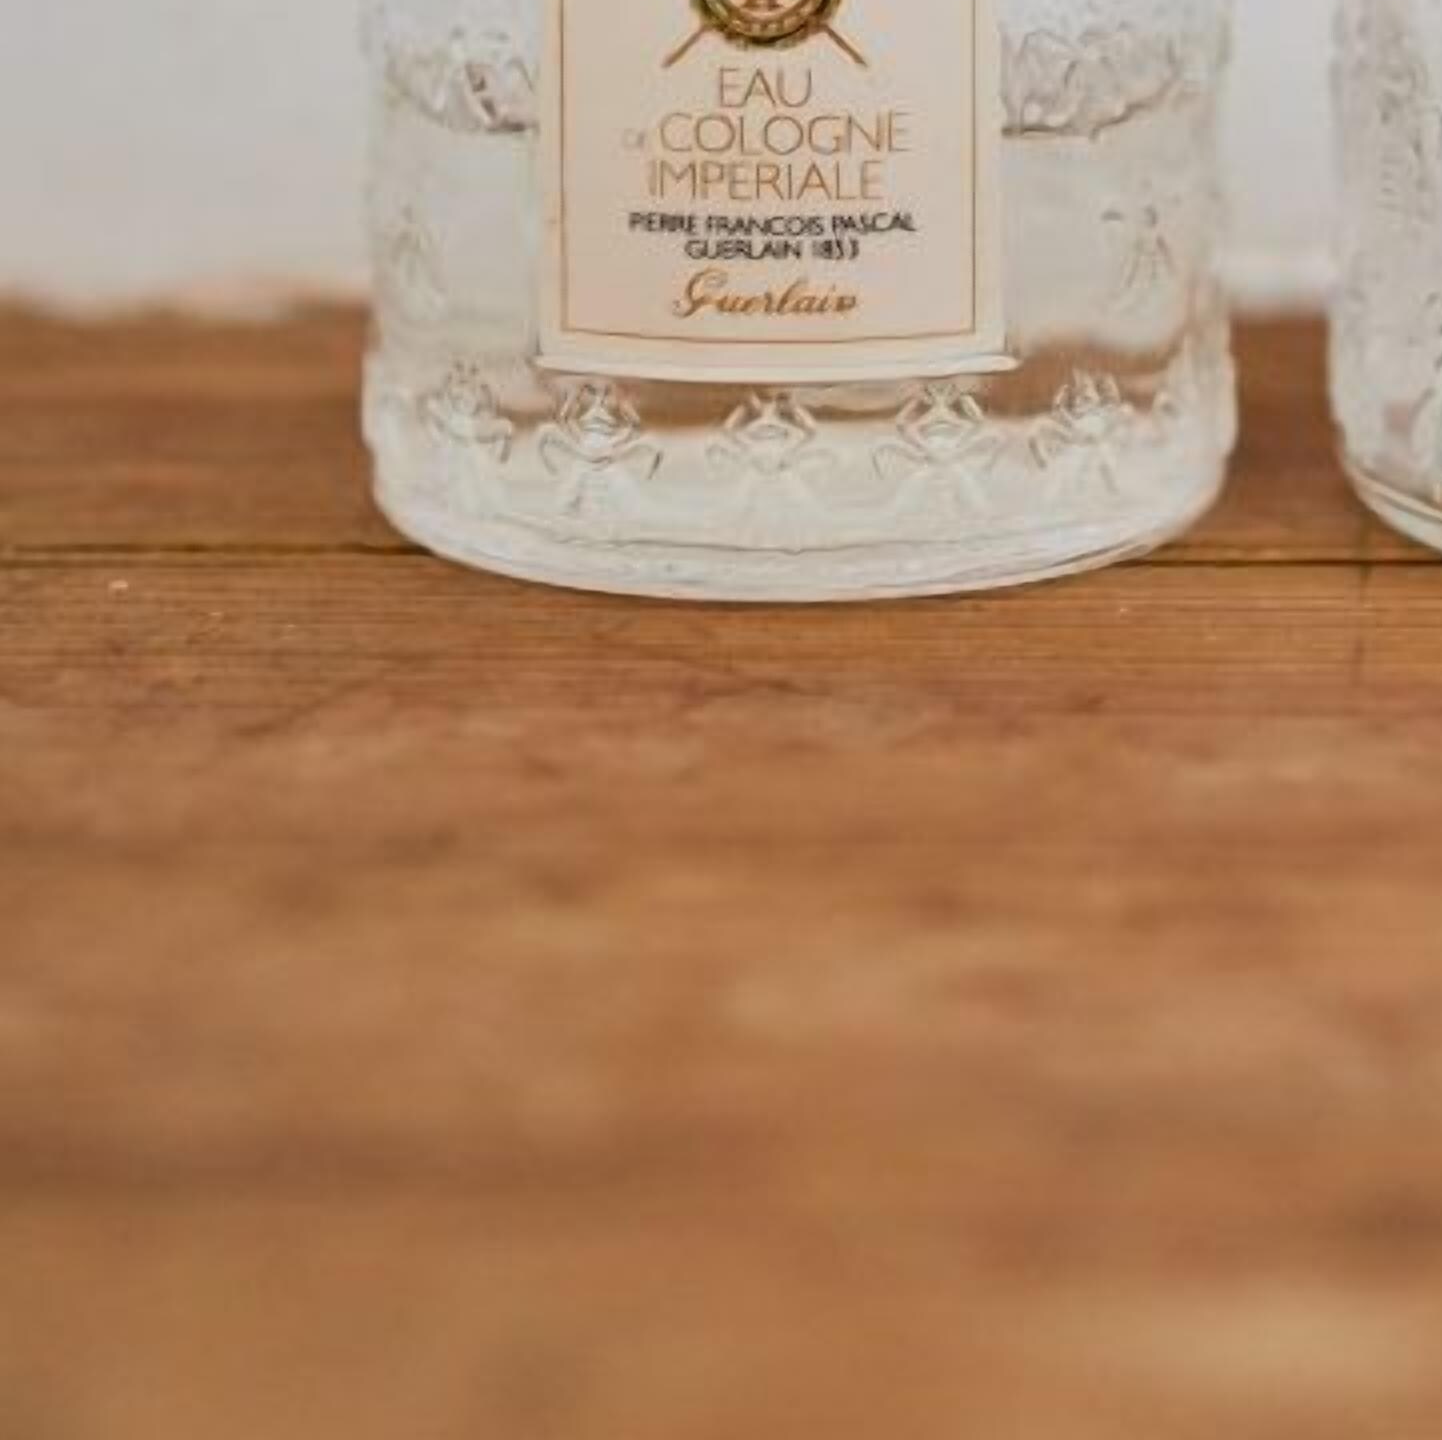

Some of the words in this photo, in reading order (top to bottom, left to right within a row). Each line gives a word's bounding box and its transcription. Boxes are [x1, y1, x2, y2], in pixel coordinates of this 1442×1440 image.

[718, 67, 812, 108] EAU
[659, 110, 913, 155] COLOGNE
[649, 158, 884, 201] IMPERIALE
[684, 238, 802, 261] GUERLAIN
[672, 267, 858, 318] Guerlain
